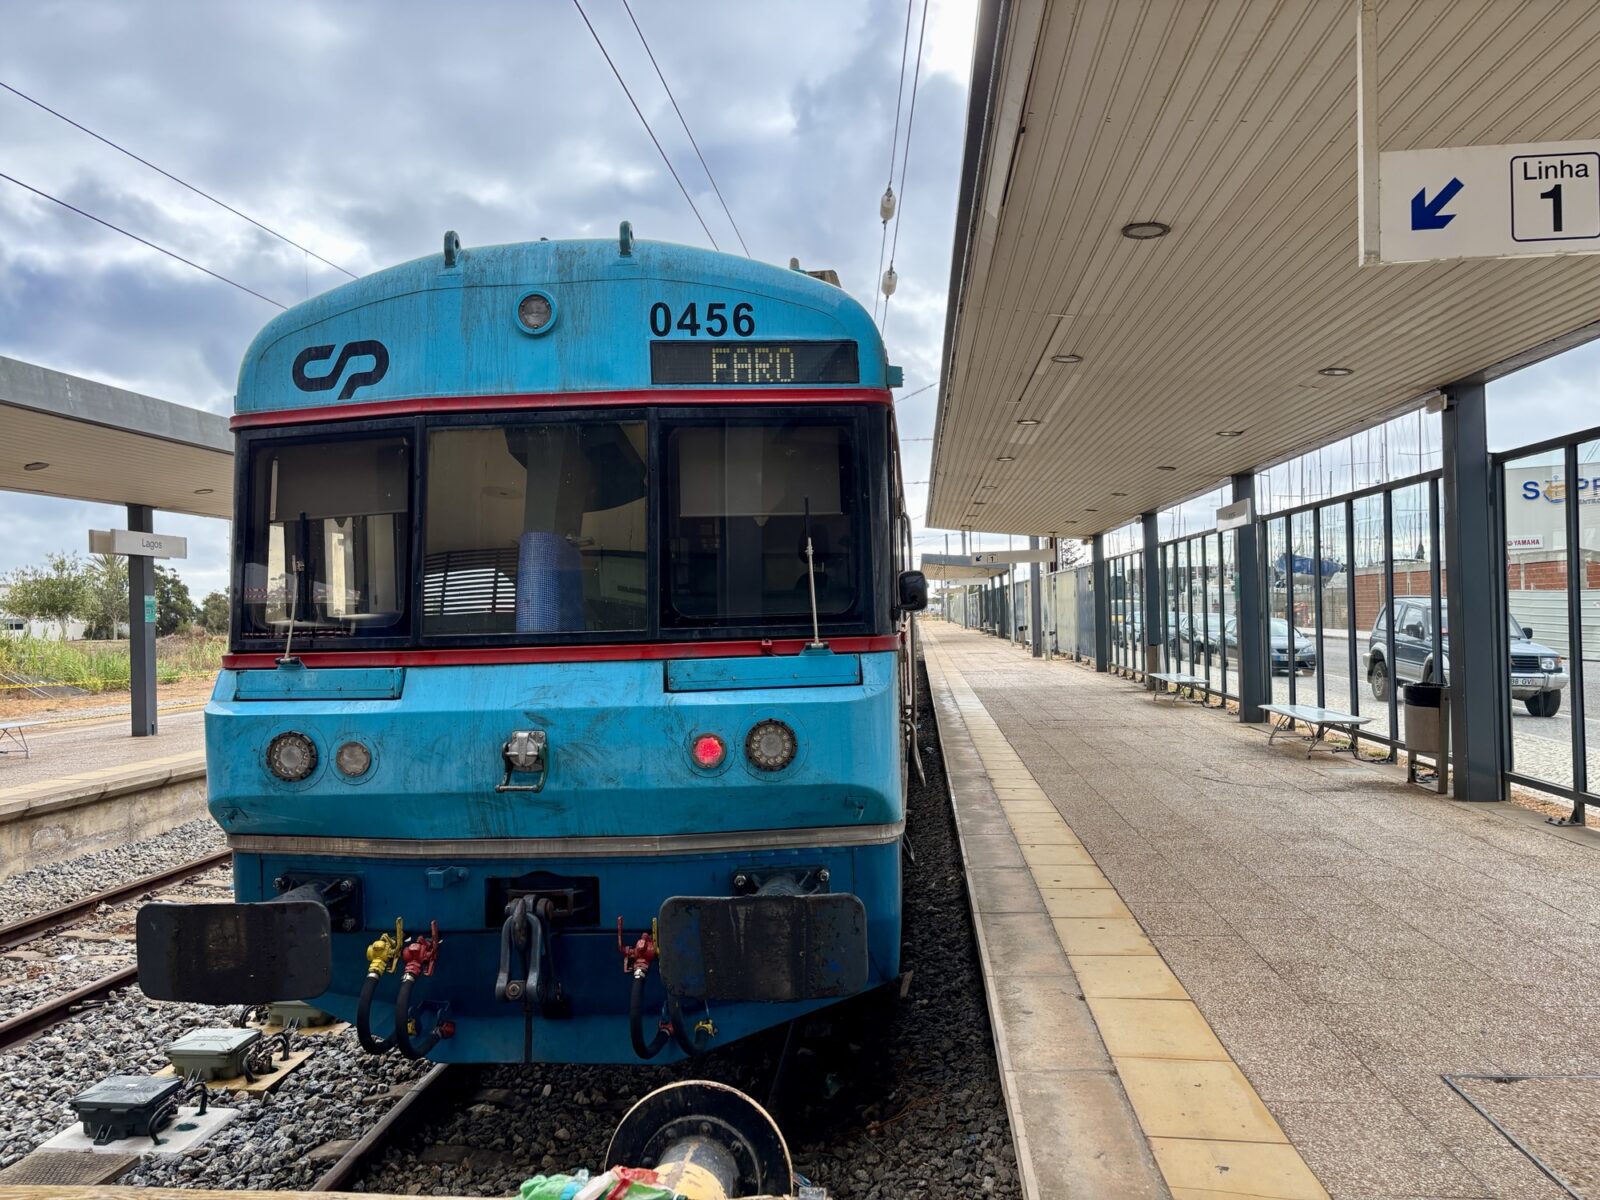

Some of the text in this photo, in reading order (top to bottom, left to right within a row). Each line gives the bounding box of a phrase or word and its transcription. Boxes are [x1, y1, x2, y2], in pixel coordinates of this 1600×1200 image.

[1523, 160, 1590, 181] Linha
[1540, 184, 1563, 232] 1
[650, 302, 755, 337] 0456
[712, 347, 794, 383] FARO
[141, 538, 163, 550] Lagos
[1514, 538, 1540, 546] YAMAHA
